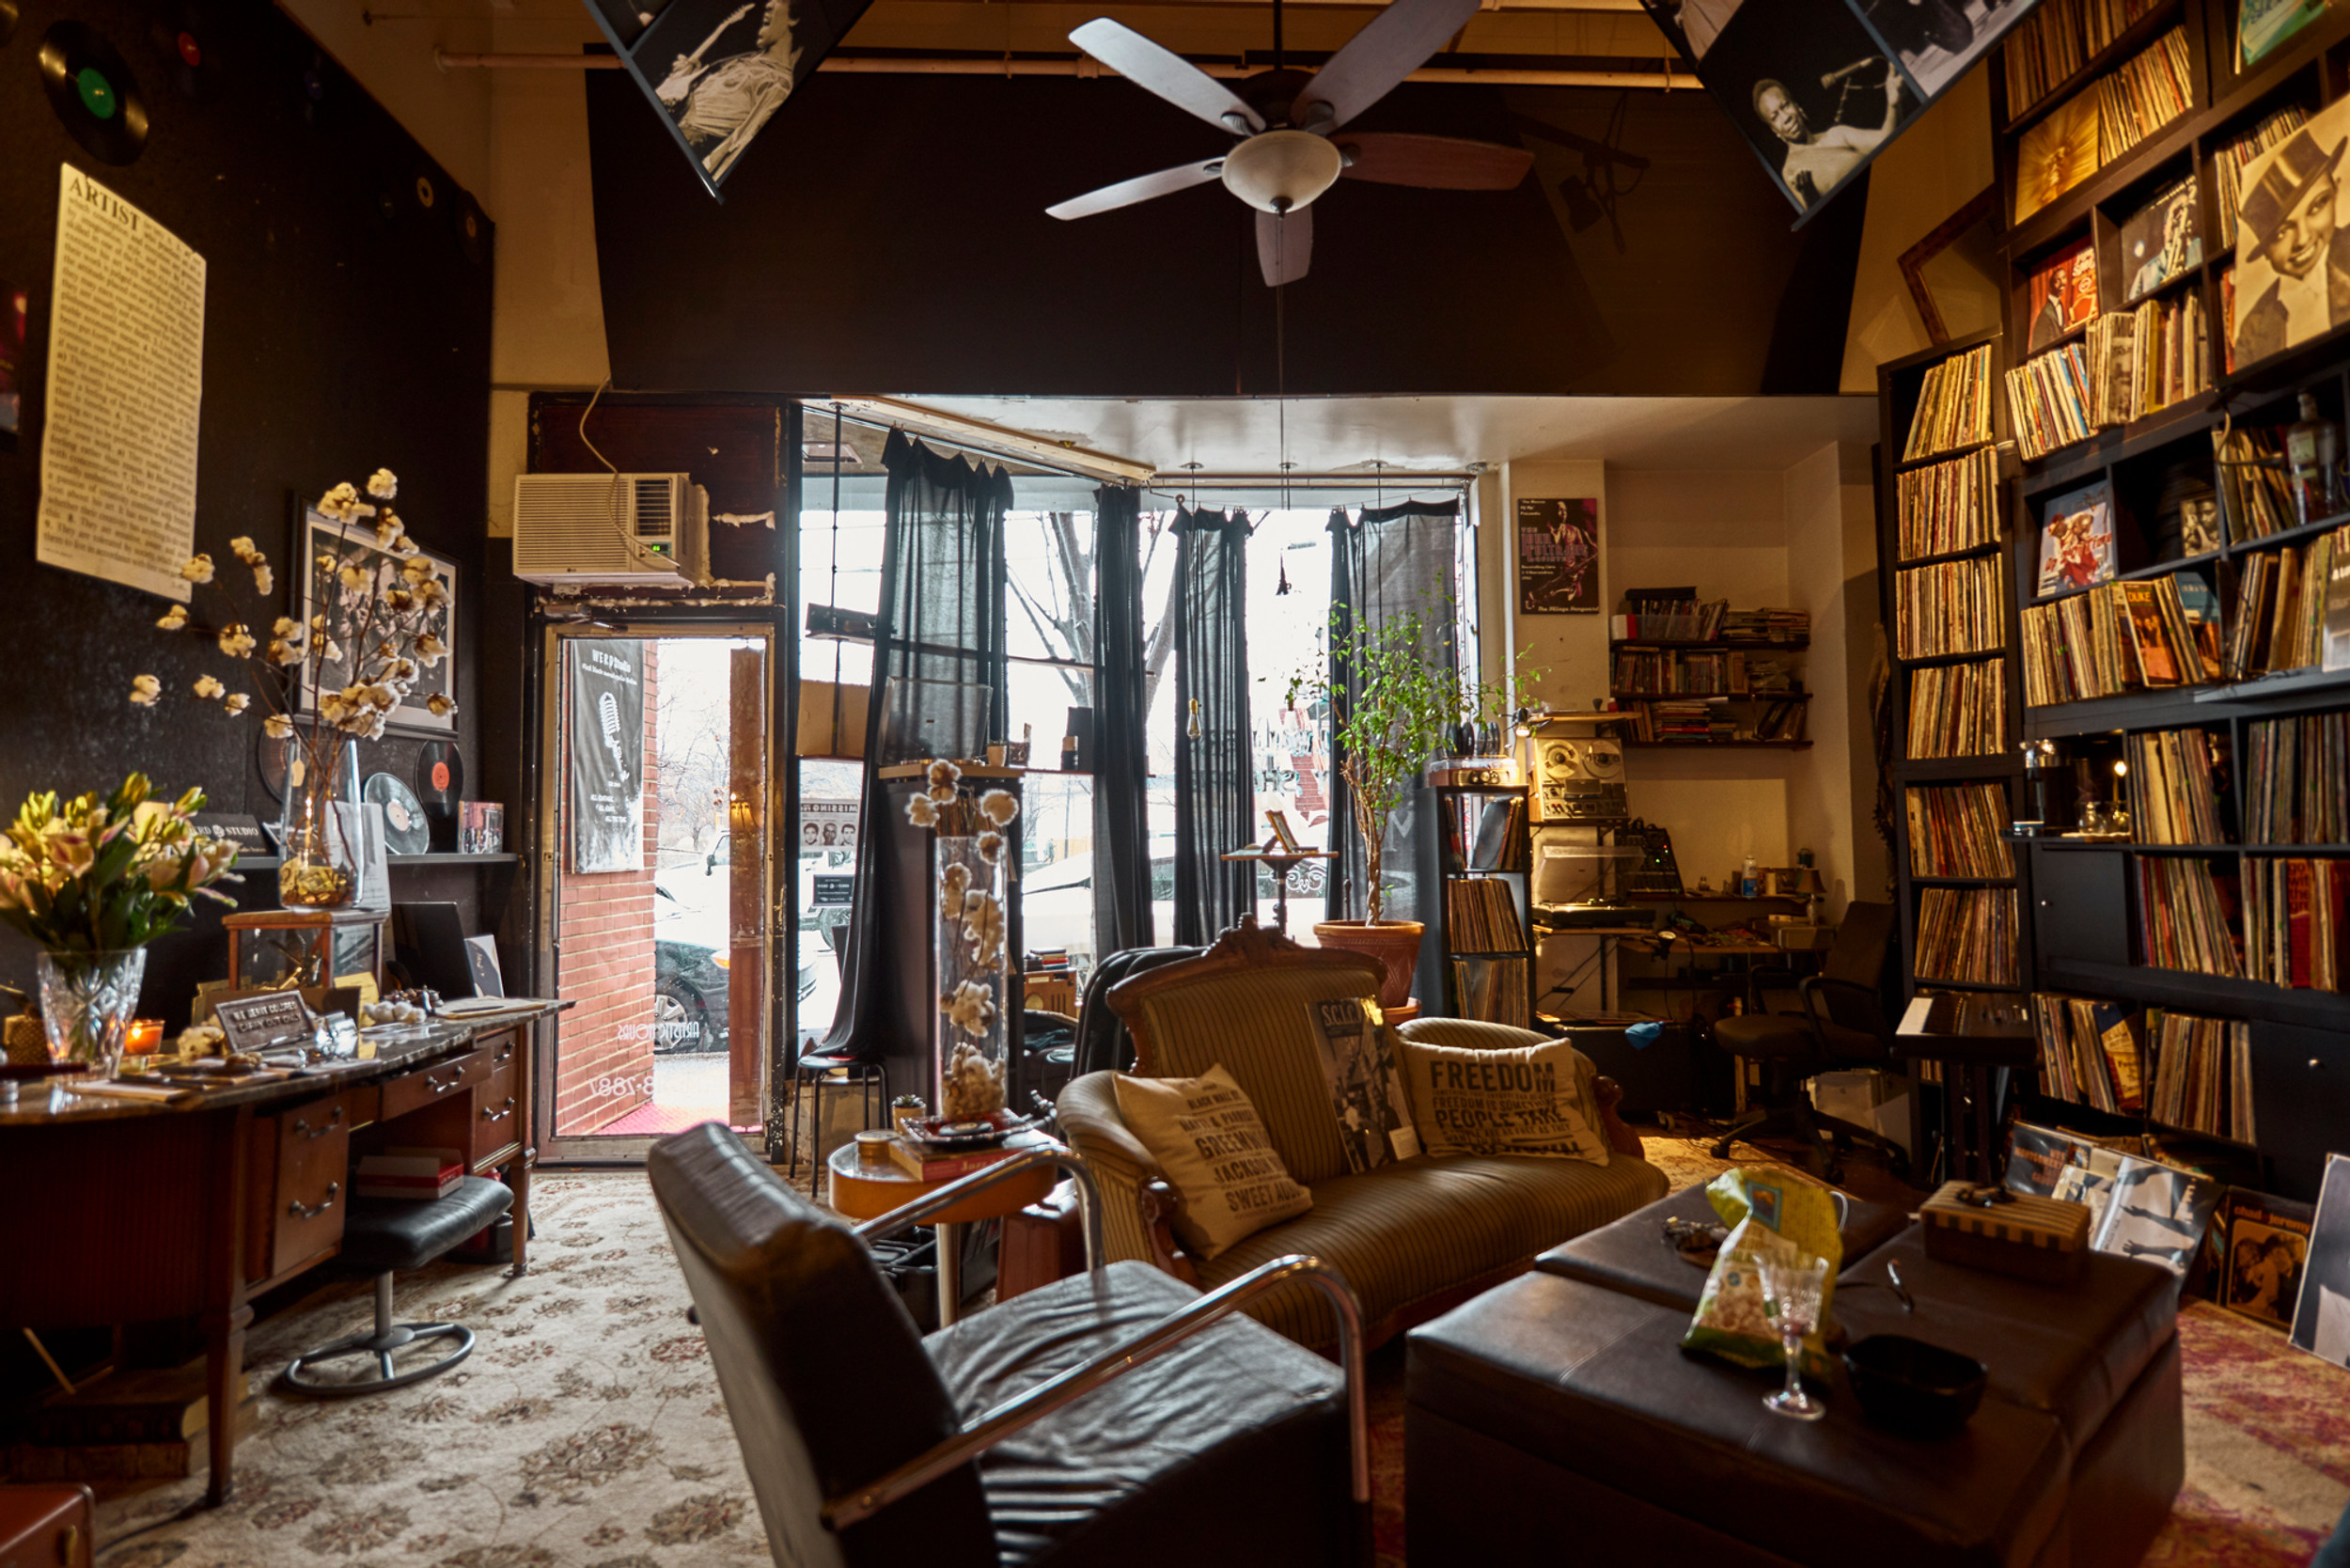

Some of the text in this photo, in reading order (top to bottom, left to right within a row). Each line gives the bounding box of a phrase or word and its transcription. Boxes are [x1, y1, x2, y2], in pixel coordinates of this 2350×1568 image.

[70, 177, 140, 231] ARTIST
[2127, 591, 2152, 603] DUKE
[226, 826, 259, 837] STUDIO
[1430, 1060, 1556, 1092] FREEDOM
[1187, 1097, 1213, 1110] BLACK
[1213, 1092, 1230, 1104] WALL
[1433, 1097, 1484, 1109] FREEDOM
[1486, 1099, 1497, 1110] IS
[1434, 1105, 1571, 1129] PEOPLE TAKE
[960, 1160, 985, 1172] Jazz
[1214, 1157, 1274, 1184] JACKSON
[1225, 1184, 1284, 1212] SWEET
[2233, 1205, 2264, 1221] chad
[2268, 1213, 2311, 1235] jeremy
